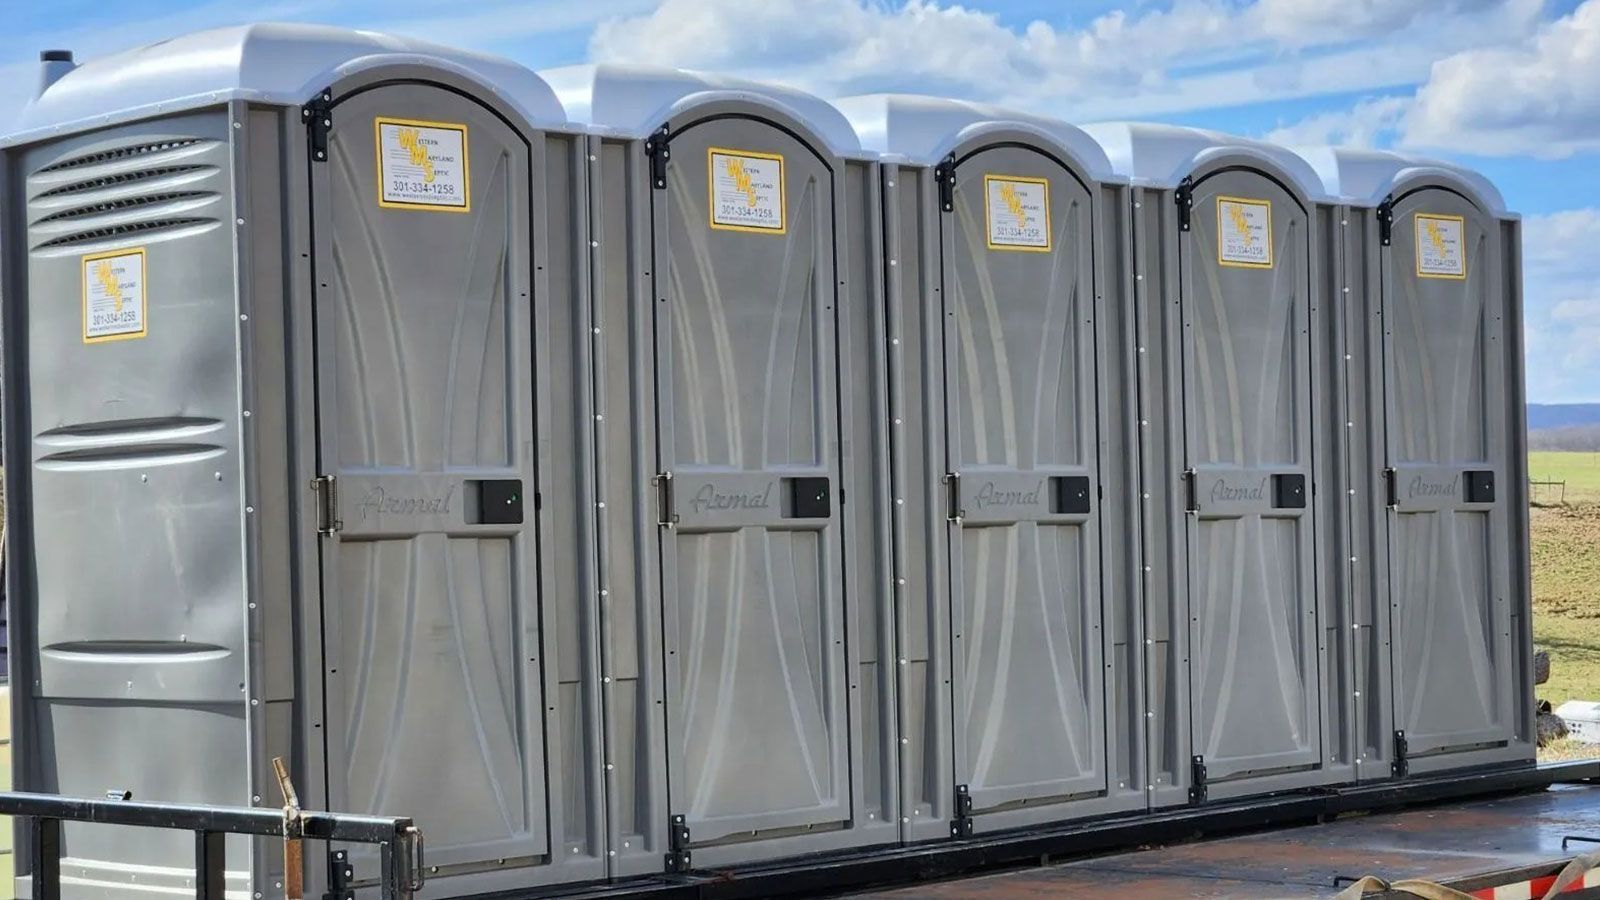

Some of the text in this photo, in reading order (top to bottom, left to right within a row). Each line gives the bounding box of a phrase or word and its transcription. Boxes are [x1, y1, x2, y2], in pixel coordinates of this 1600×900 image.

[393, 181, 454, 195] 301-334-1258
[721, 204, 773, 218] 301-334-1258
[93, 310, 136, 326] 301-334-1258
[690, 482, 773, 513] Armal
[974, 480, 1042, 509] Armal
[1210, 477, 1267, 504] Armal
[1408, 474, 1459, 498] Armal
[356, 484, 455, 524] Armal
